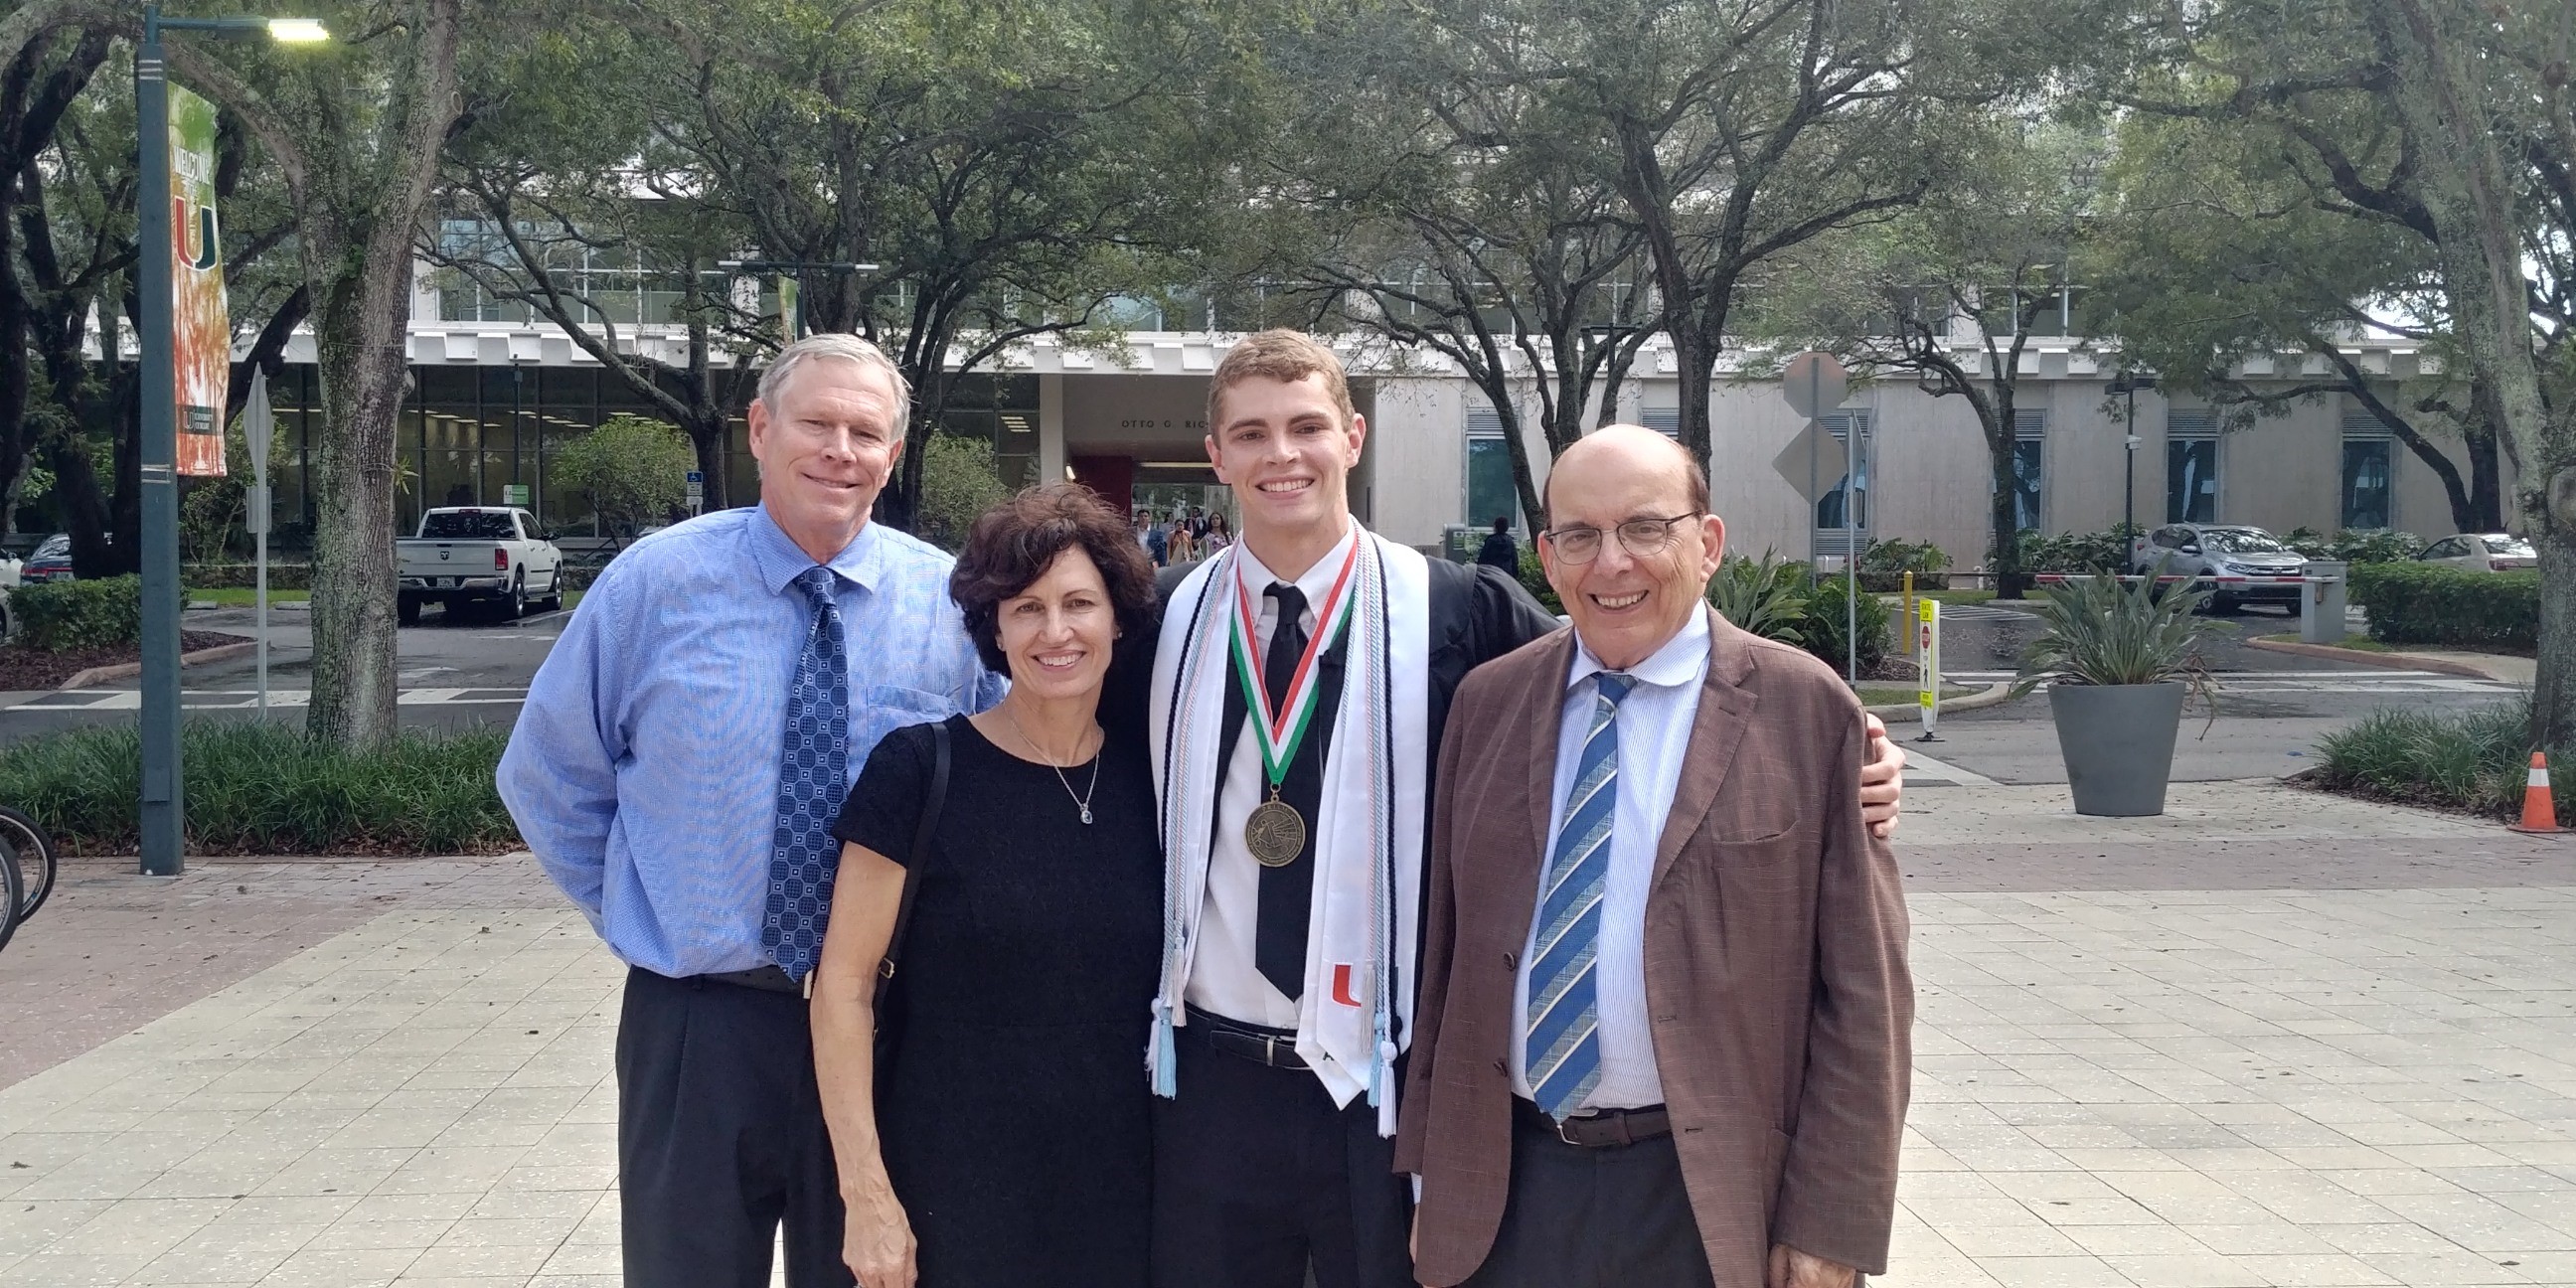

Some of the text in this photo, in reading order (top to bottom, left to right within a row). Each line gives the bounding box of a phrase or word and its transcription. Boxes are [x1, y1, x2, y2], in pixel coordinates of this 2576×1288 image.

[174, 195, 218, 271] U
[1121, 419, 1155, 428] OTTO
[1163, 419, 1172, 428] G
